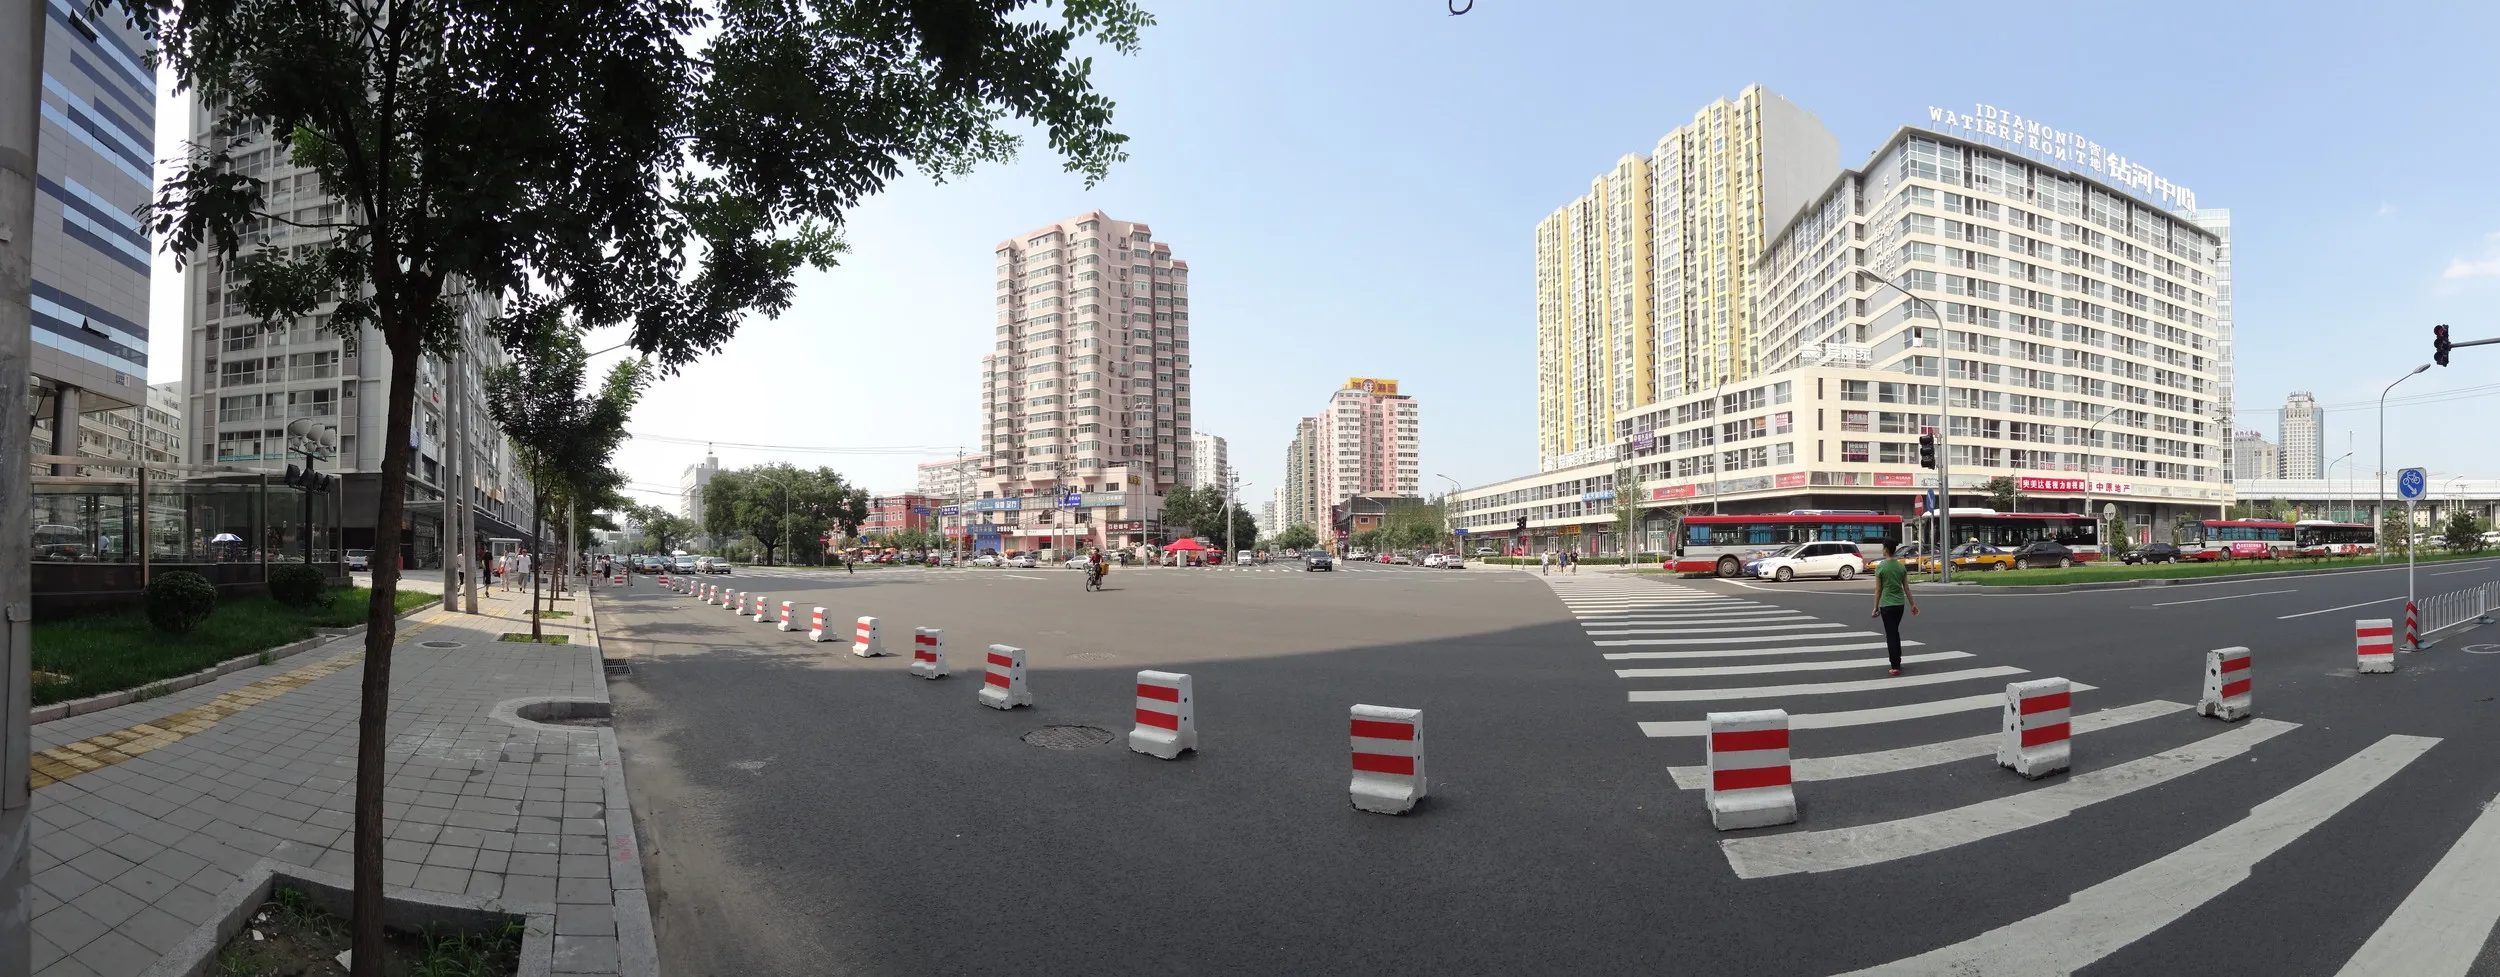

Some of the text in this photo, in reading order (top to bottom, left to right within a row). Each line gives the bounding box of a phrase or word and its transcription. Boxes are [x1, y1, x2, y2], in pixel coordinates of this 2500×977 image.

[2106, 152, 2197, 214] 钻河中心
[2095, 482, 2131, 493] 中原地产
